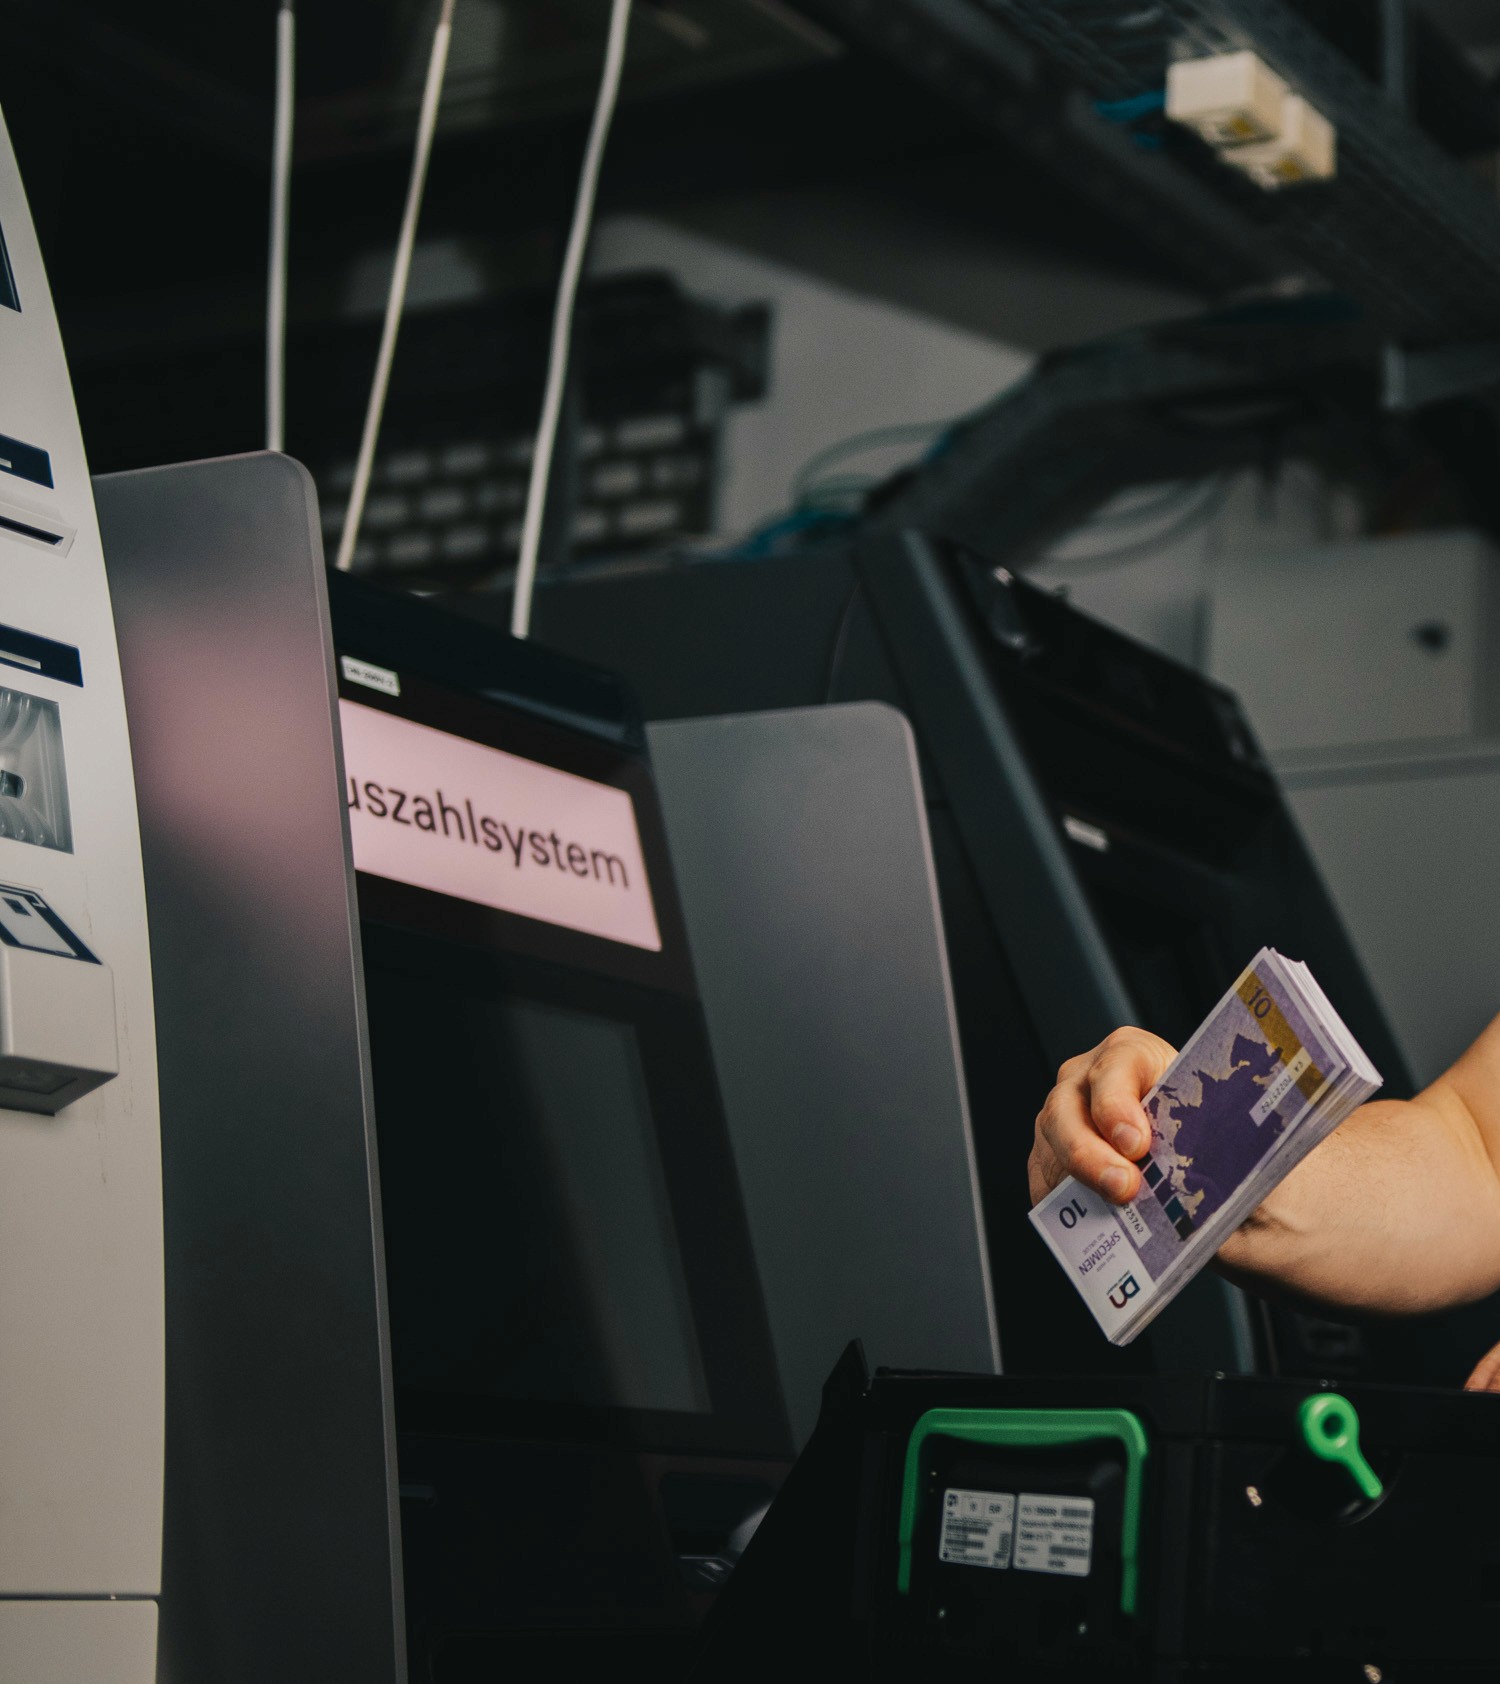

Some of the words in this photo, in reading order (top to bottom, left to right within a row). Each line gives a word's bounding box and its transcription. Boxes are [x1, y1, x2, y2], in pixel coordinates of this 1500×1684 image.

[347, 778, 629, 888] uszahlsystem
[1247, 987, 1272, 1019] 10
[1059, 1199, 1088, 1229] 10
[1123, 1204, 1144, 1234] 225762
[1078, 1231, 1120, 1276] SPECIMEN
